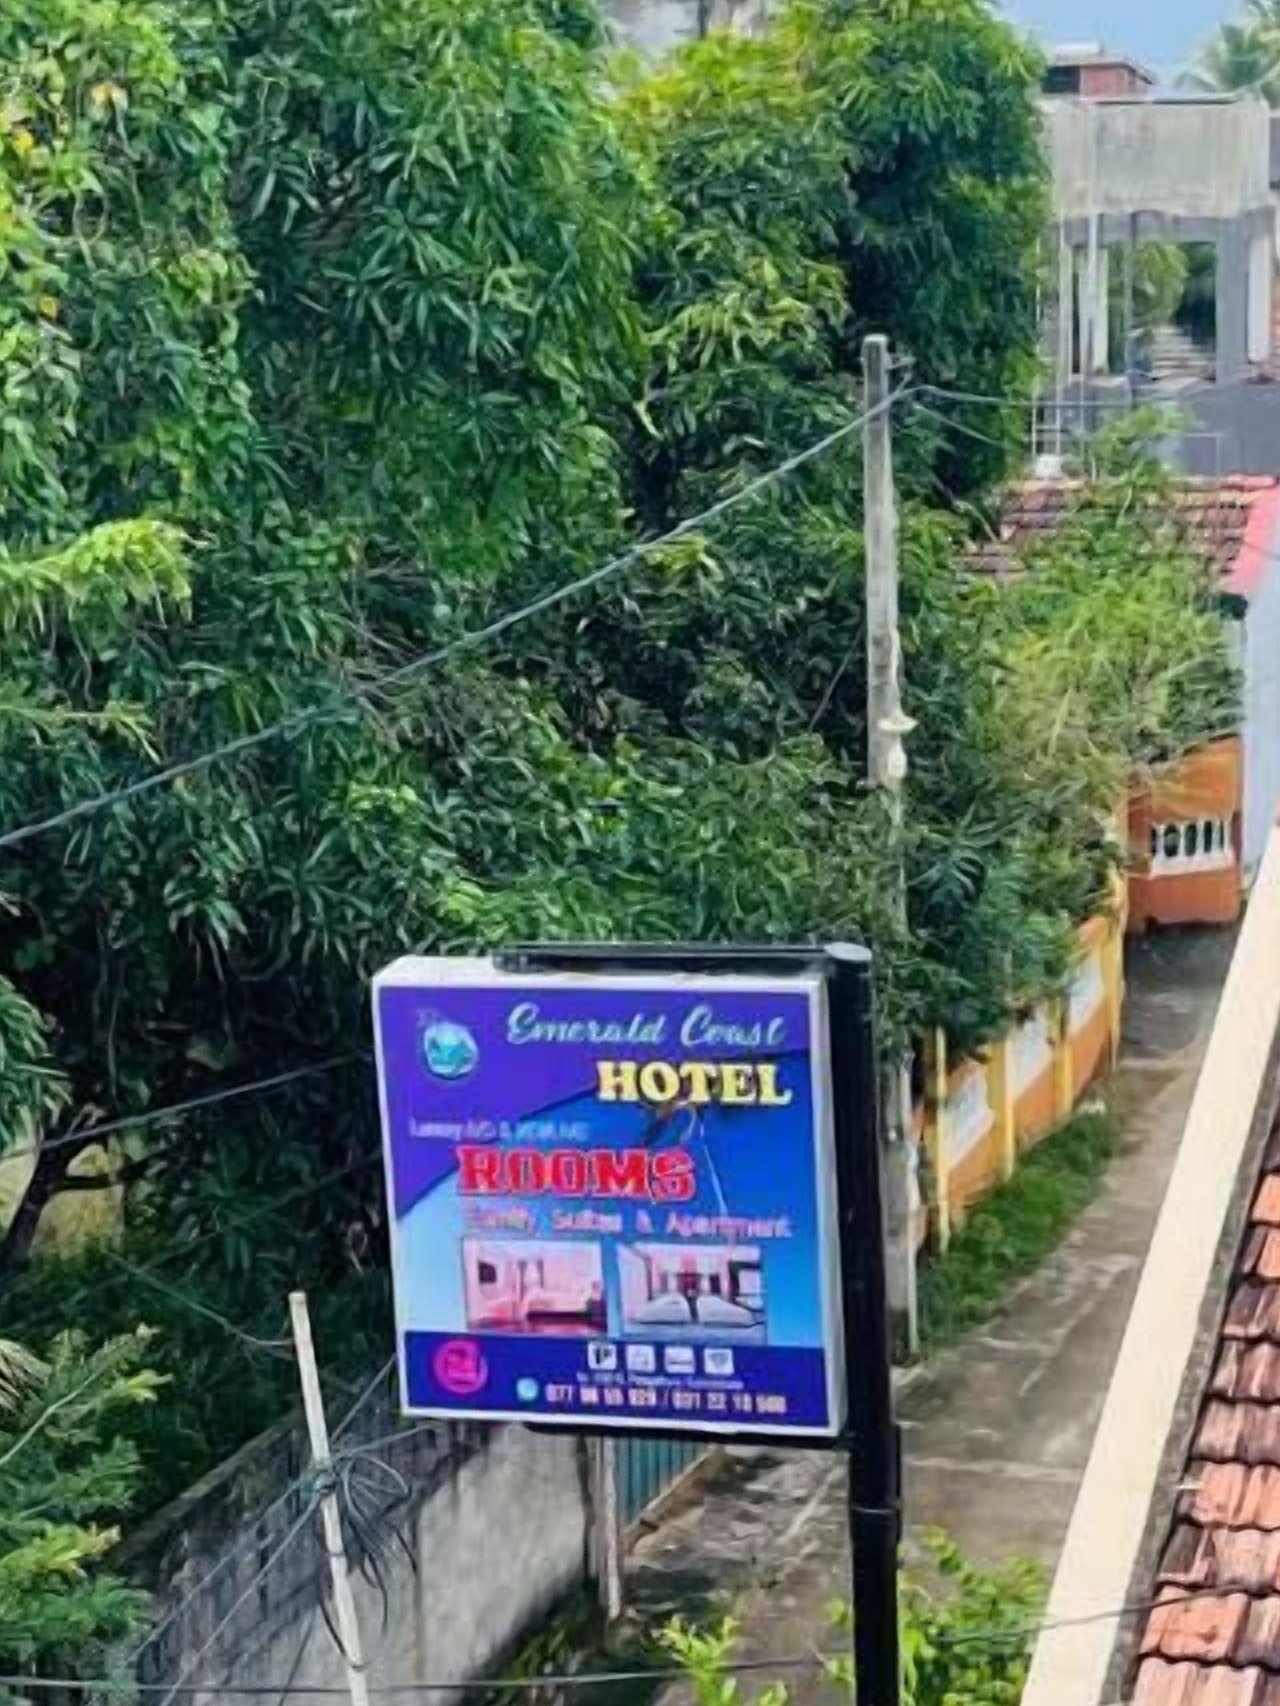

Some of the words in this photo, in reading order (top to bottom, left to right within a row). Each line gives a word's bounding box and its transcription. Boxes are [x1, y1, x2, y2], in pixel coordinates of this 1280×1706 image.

[507, 1002, 666, 1045] Emerald
[680, 1004, 786, 1047] Coast
[596, 1060, 793, 1105] HOTEL
[456, 1145, 696, 1202] ROOMS
